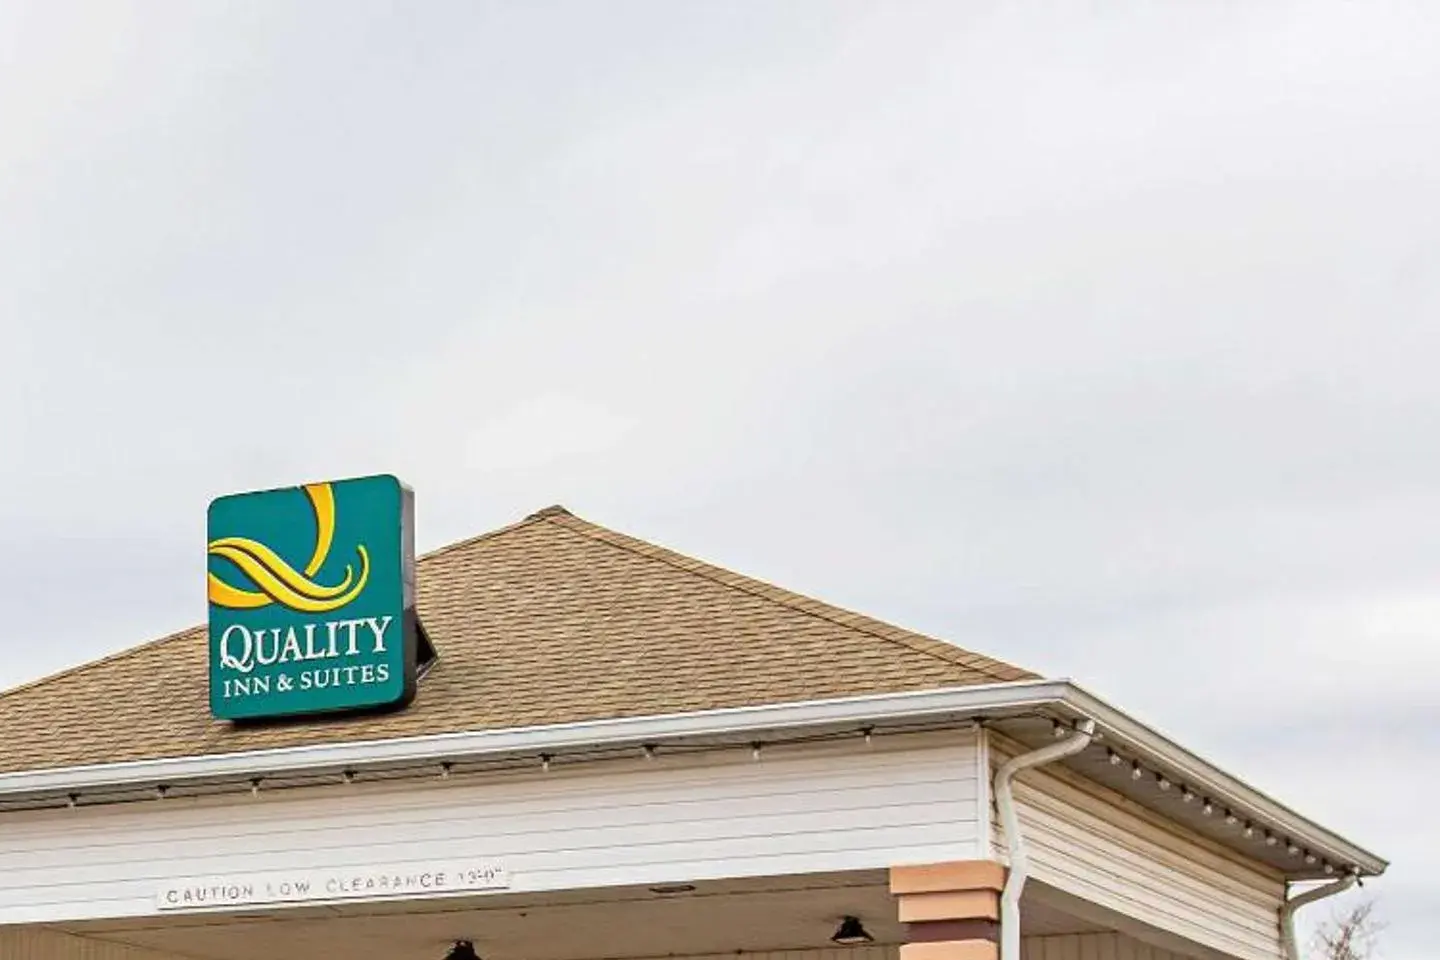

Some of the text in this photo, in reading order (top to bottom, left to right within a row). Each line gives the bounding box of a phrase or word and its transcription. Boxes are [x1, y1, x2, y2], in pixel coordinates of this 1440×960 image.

[220, 615, 392, 673] QUALITY
[224, 664, 389, 698] INN & SUITES
[166, 886, 253, 903] CAUTION
[266, 881, 310, 897] LOW
[326, 873, 445, 893] CLEARANCE
